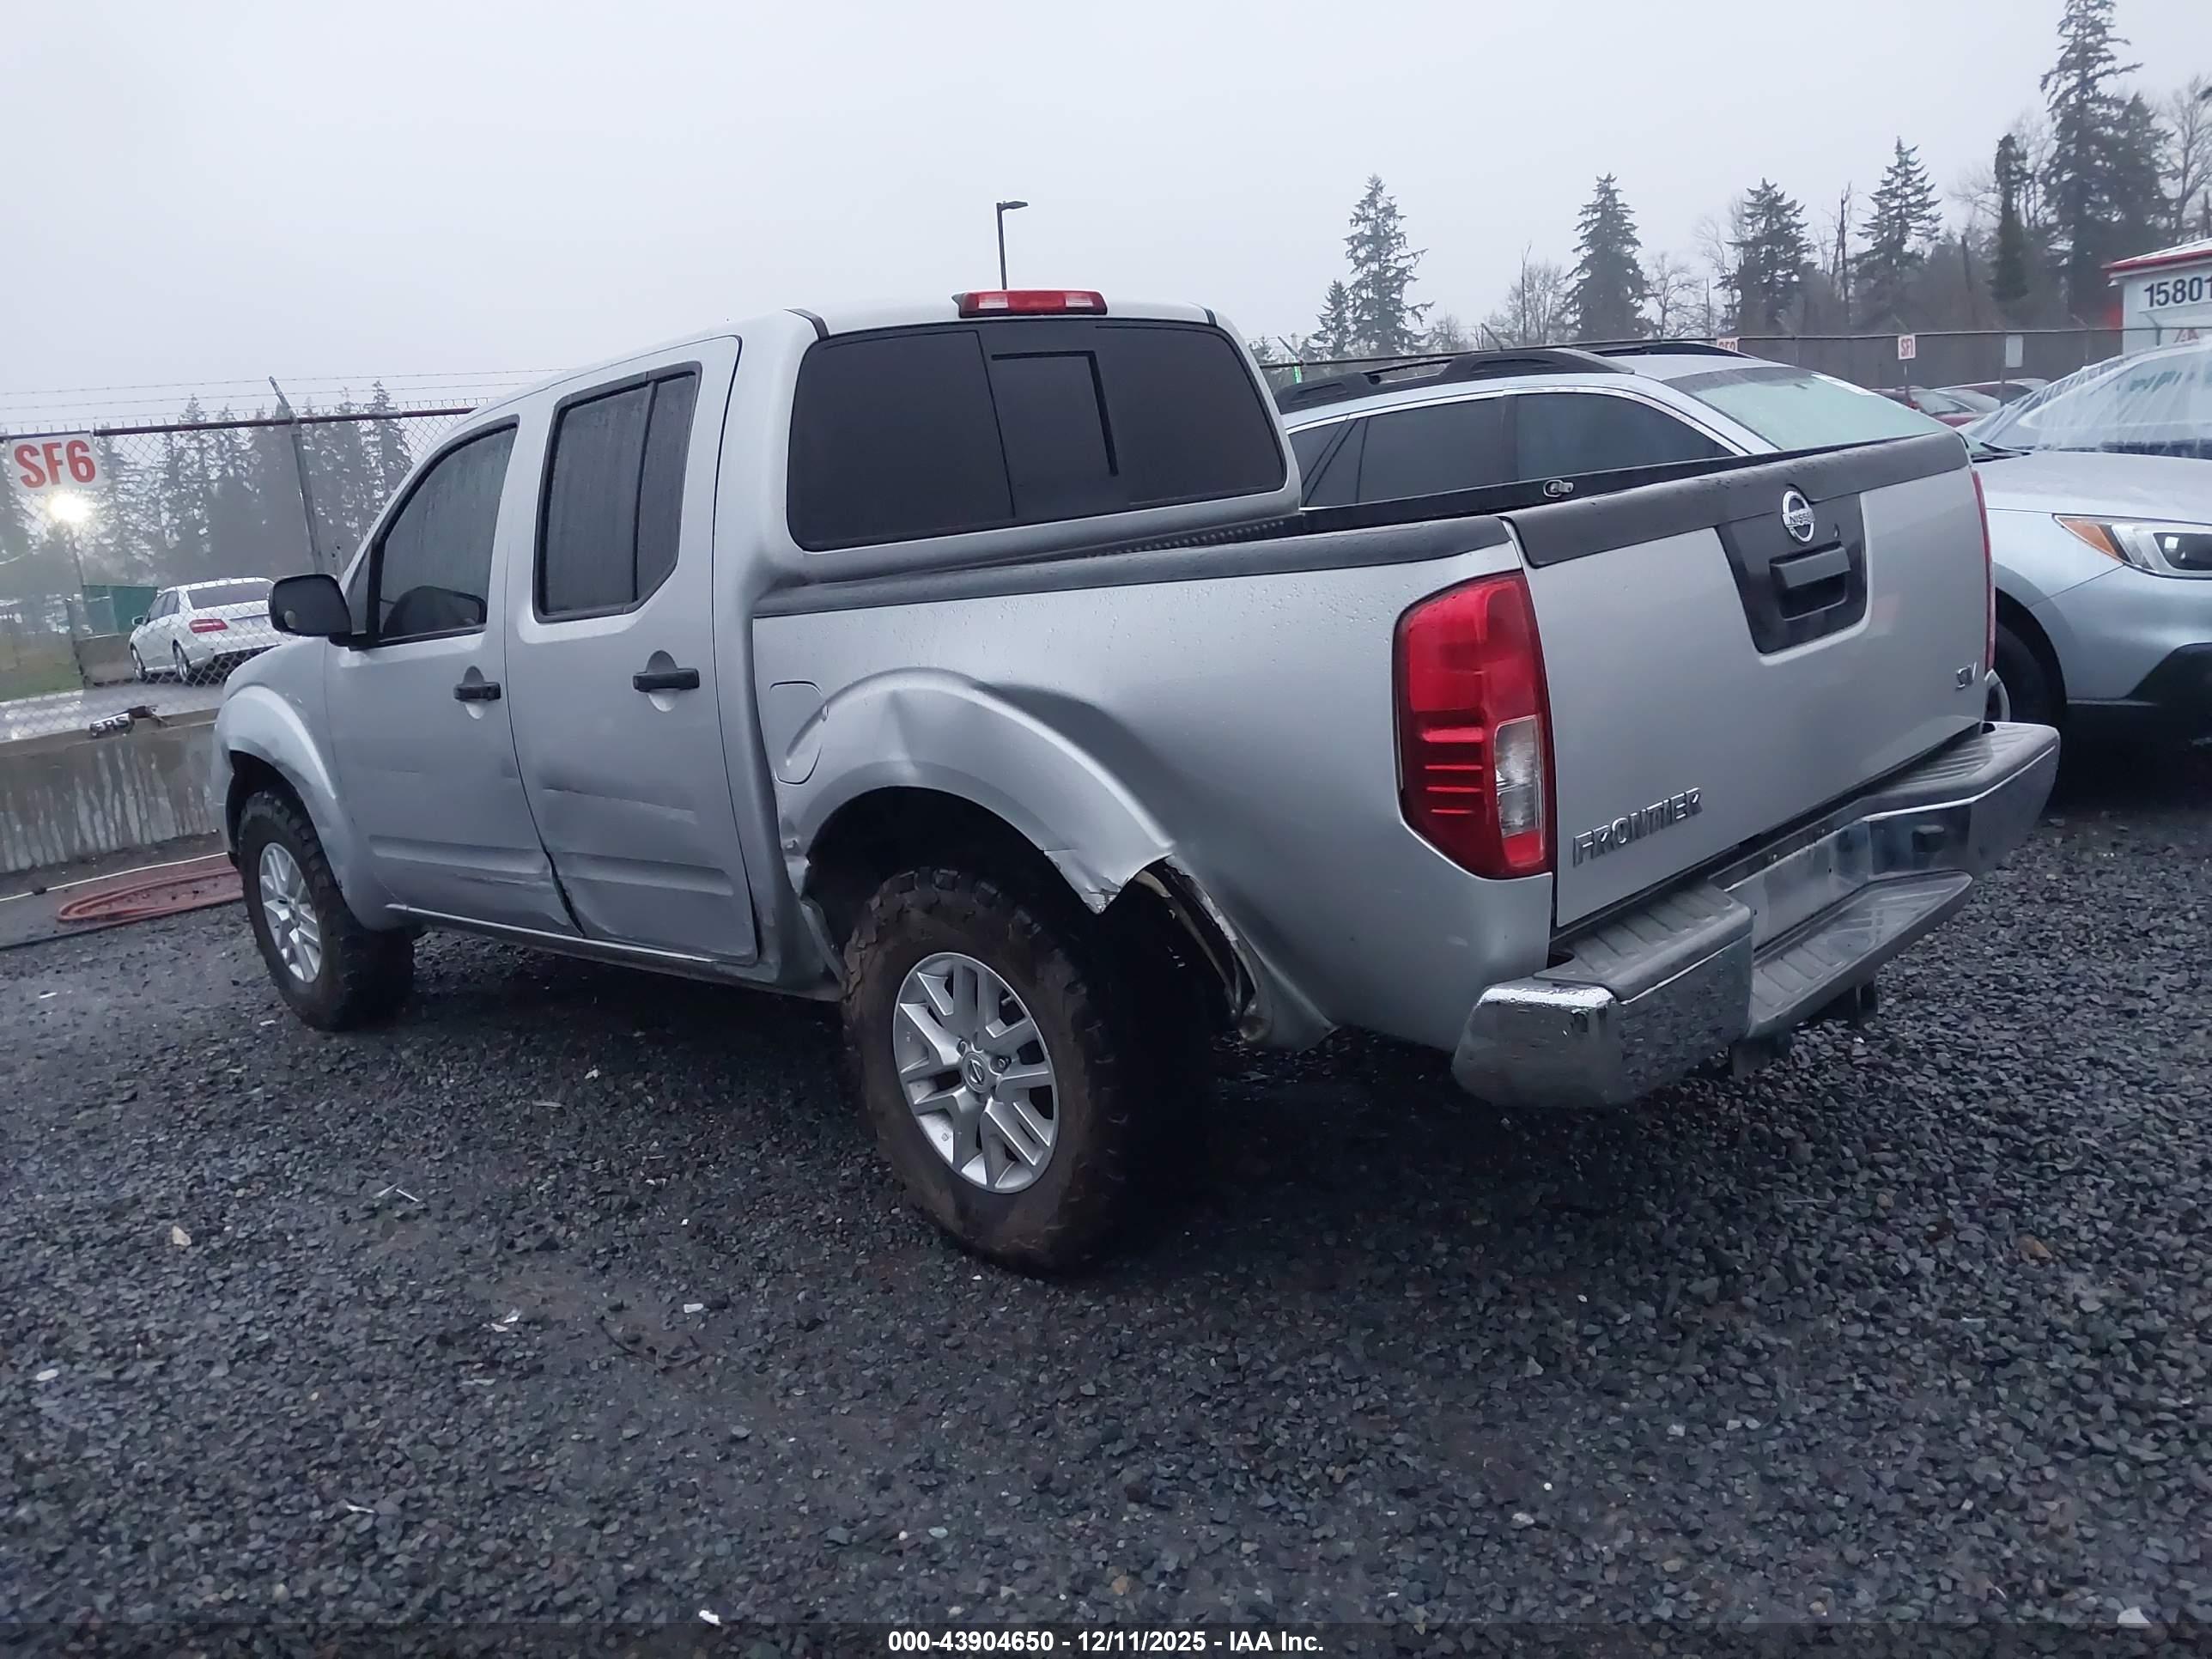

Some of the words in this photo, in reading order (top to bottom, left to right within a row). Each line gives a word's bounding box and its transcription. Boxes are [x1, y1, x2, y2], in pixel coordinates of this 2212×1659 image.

[2144, 276, 2212, 307] 15801
[14, 440, 96, 488] SF6
[1572, 787, 1703, 868] FRONTIER
